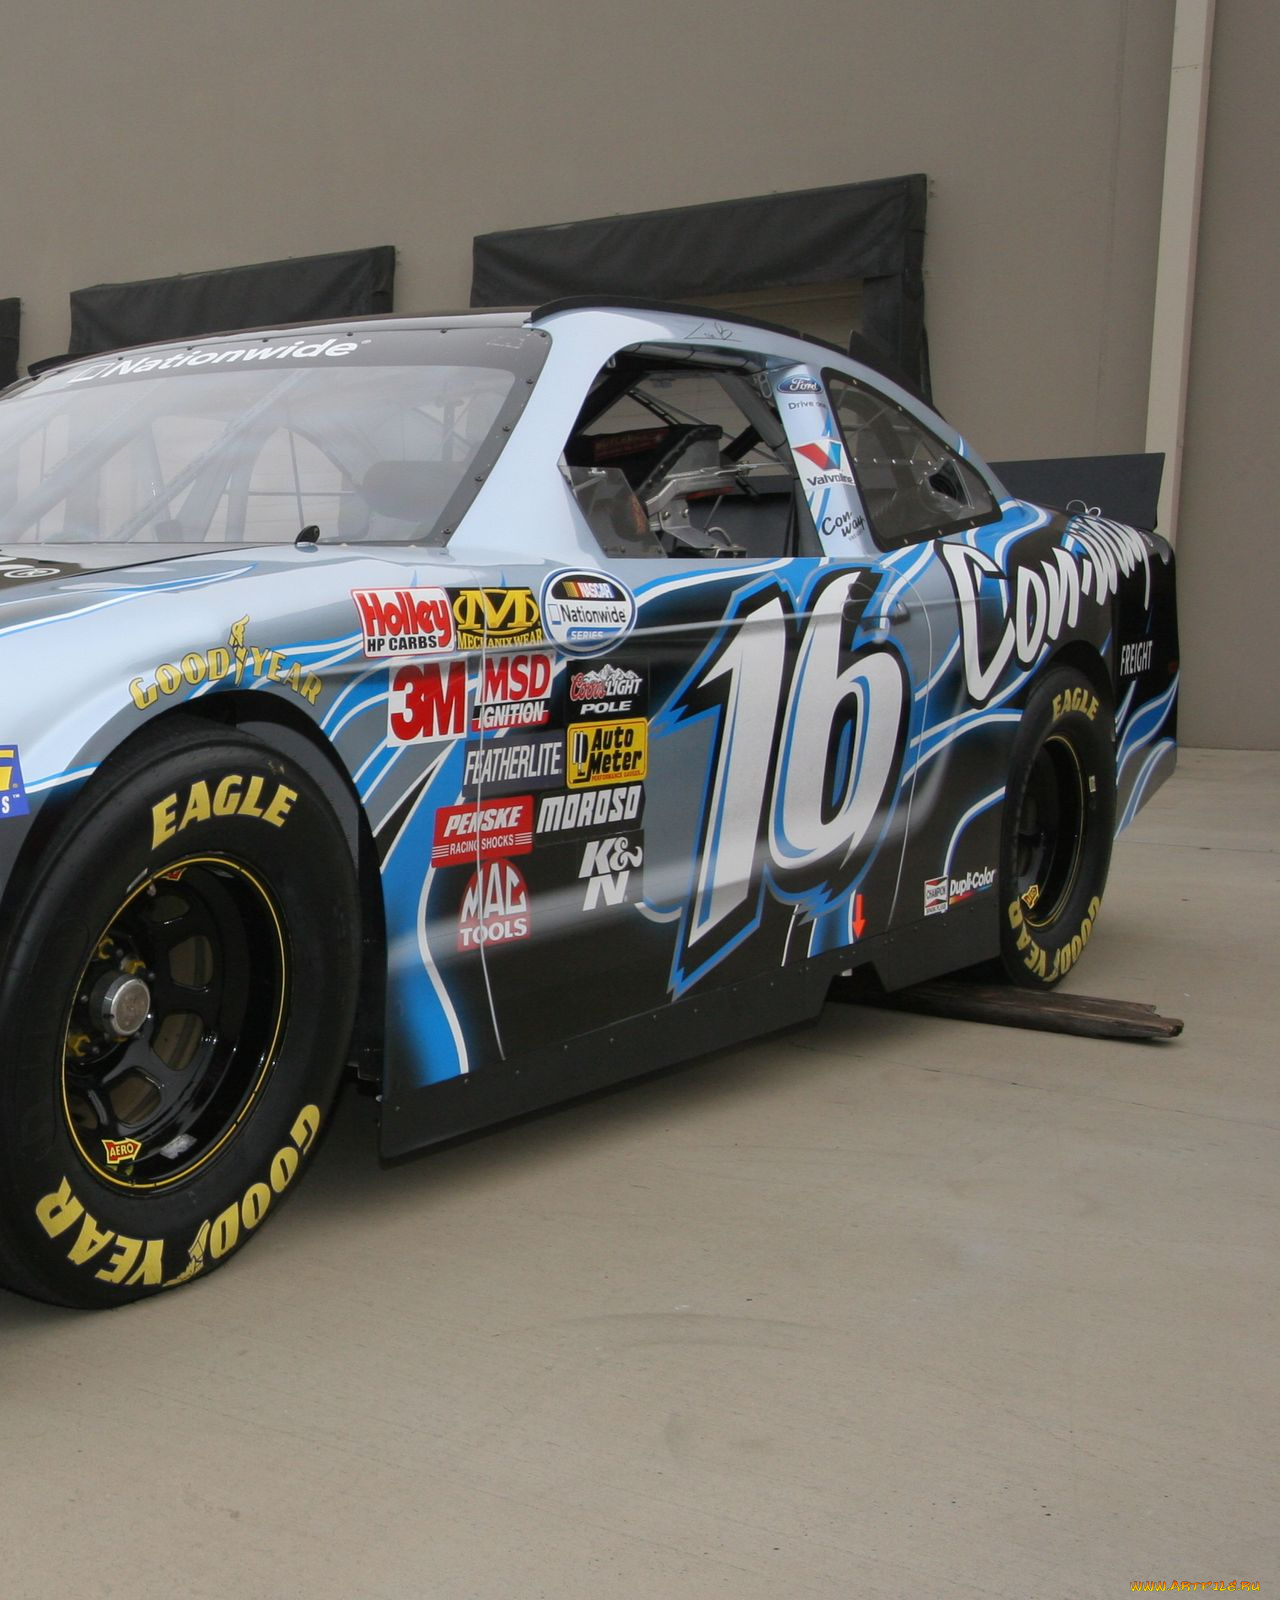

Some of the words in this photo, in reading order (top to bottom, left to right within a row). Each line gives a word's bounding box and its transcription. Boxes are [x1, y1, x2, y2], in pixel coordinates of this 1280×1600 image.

[100, 338, 358, 378] Nationwide
[790, 378, 817, 391] Ford
[788, 401, 814, 410] Drive
[807, 473, 854, 486] Valvoline
[578, 582, 614, 598] NASCAR
[356, 591, 453, 649] Holley
[561, 604, 627, 623] Nationwide
[367, 635, 386, 651] HP
[388, 634, 437, 650] CARBS
[514, 629, 543, 647] WEAR
[570, 631, 604, 640] SERIES
[1120, 641, 1153, 676] FREIGHT
[483, 653, 552, 702] MSD
[570, 672, 607, 701] Coors
[606, 677, 643, 696] LIGHT
[390, 661, 467, 741] 3M
[478, 701, 545, 728] IGNITION
[580, 701, 632, 715] POLE
[1052, 687, 1099, 722] EAGLE
[591, 726, 634, 751] Auto
[463, 741, 562, 786] FEATHERLITE
[589, 749, 642, 775] Meter
[688, 571, 903, 948] 16
[151, 775, 298, 851] EAGLE
[443, 806, 523, 838] PENSKE
[536, 785, 642, 834] MOROSO
[449, 840, 480, 856] RACING
[481, 834, 514, 850] SHOCKS
[461, 862, 527, 923] MAC
[582, 870, 630, 912] N
[950, 866, 997, 896] Dupli-Color
[460, 918, 527, 947] TOOLS
[110, 1143, 135, 1157] AERO
